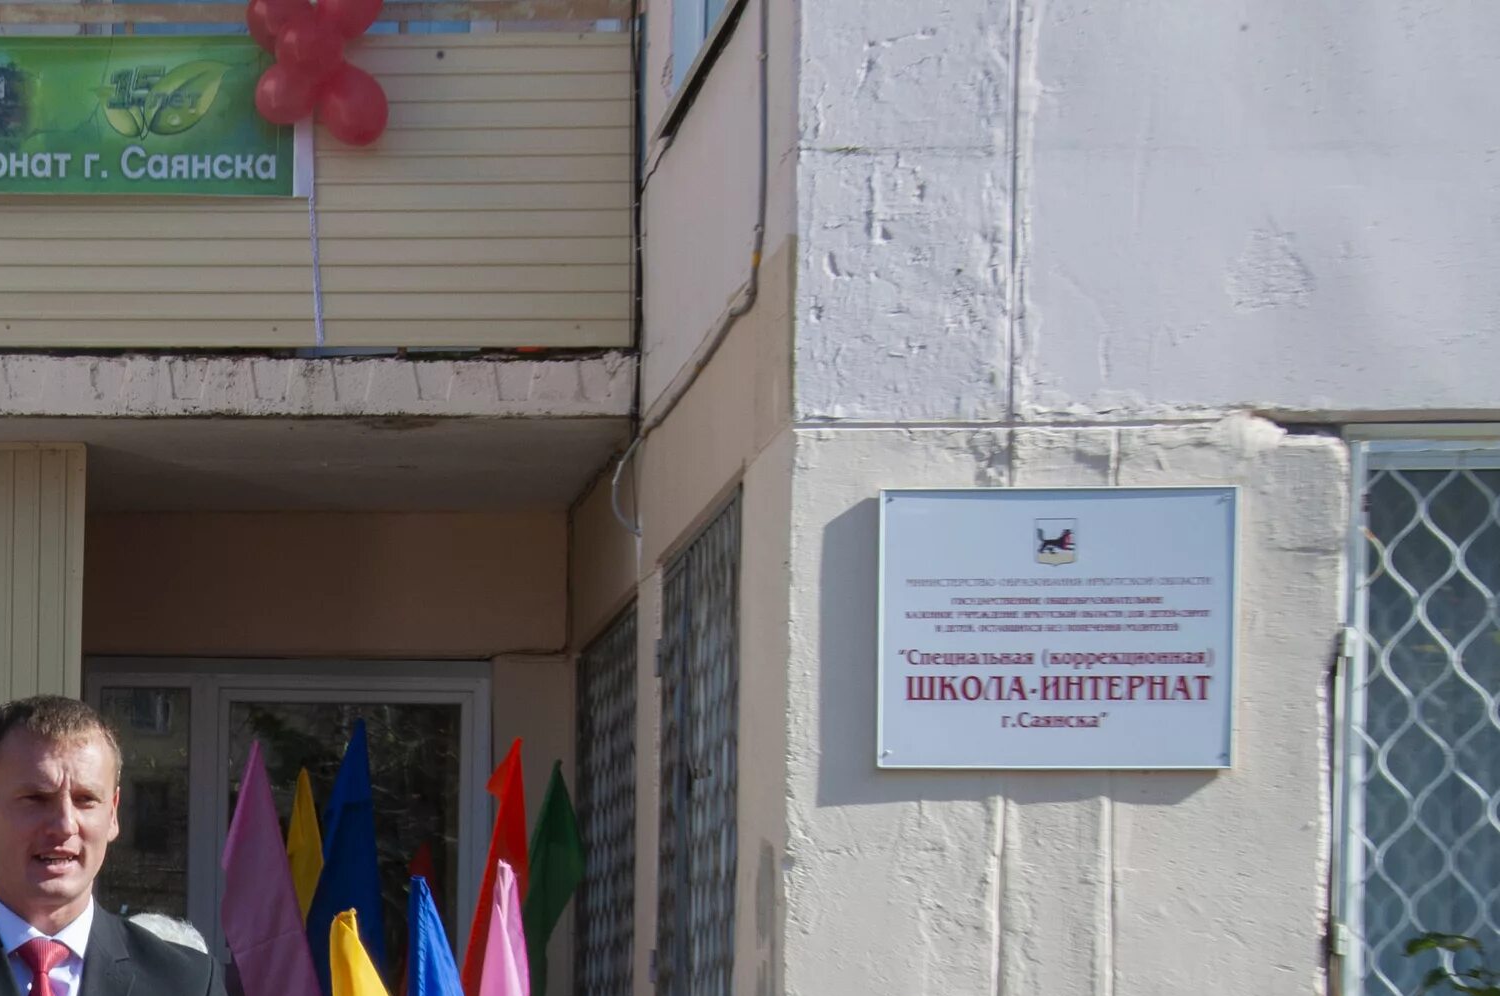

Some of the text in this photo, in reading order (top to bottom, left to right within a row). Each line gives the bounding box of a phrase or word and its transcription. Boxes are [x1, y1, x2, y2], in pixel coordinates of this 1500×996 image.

[83, 153, 108, 178] г.
[120, 145, 277, 180] Саянска
[1041, 648, 1215, 669] (коррекционная)
[905, 674, 1212, 701] ШКОЛА-ИНТЕРНАТ
